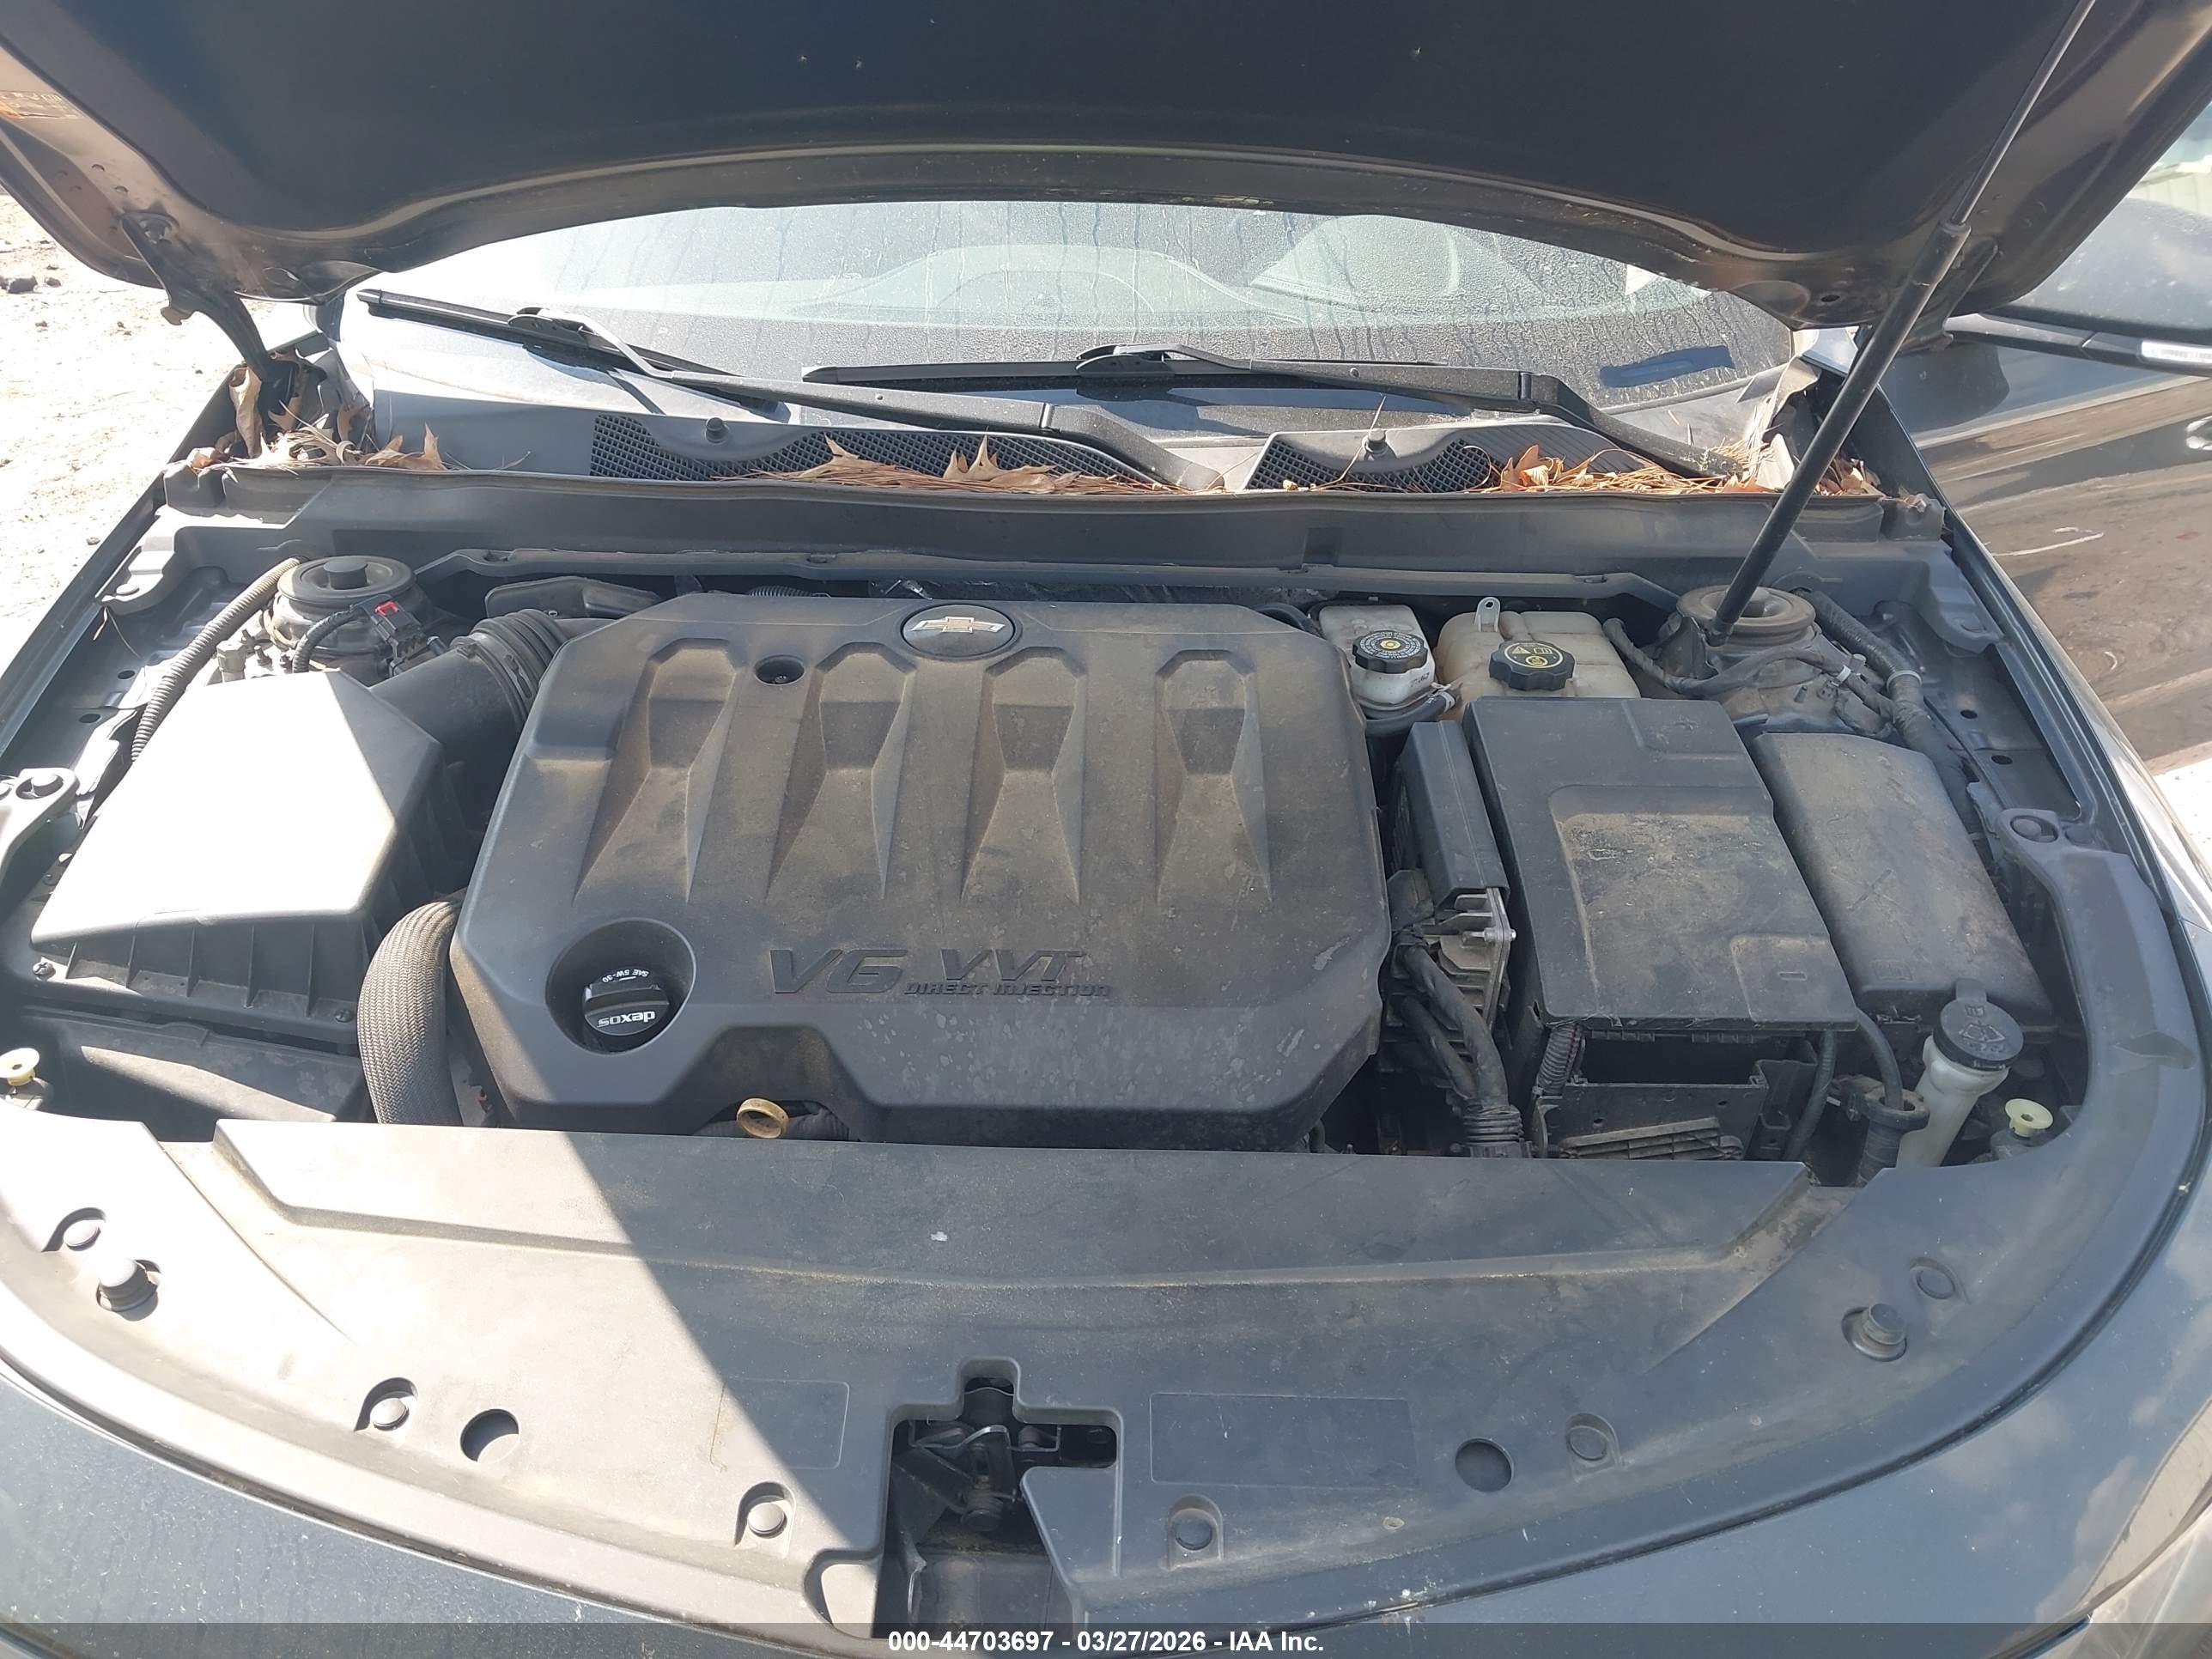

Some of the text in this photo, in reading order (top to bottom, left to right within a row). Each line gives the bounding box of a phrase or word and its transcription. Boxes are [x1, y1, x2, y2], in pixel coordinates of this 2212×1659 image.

[602, 969, 649, 983] SAE 5W-30
[770, 949, 1087, 994] V6 VVT
[904, 981, 1113, 997] DIRECT INJECTION
[597, 1011, 655, 1028] dexos
